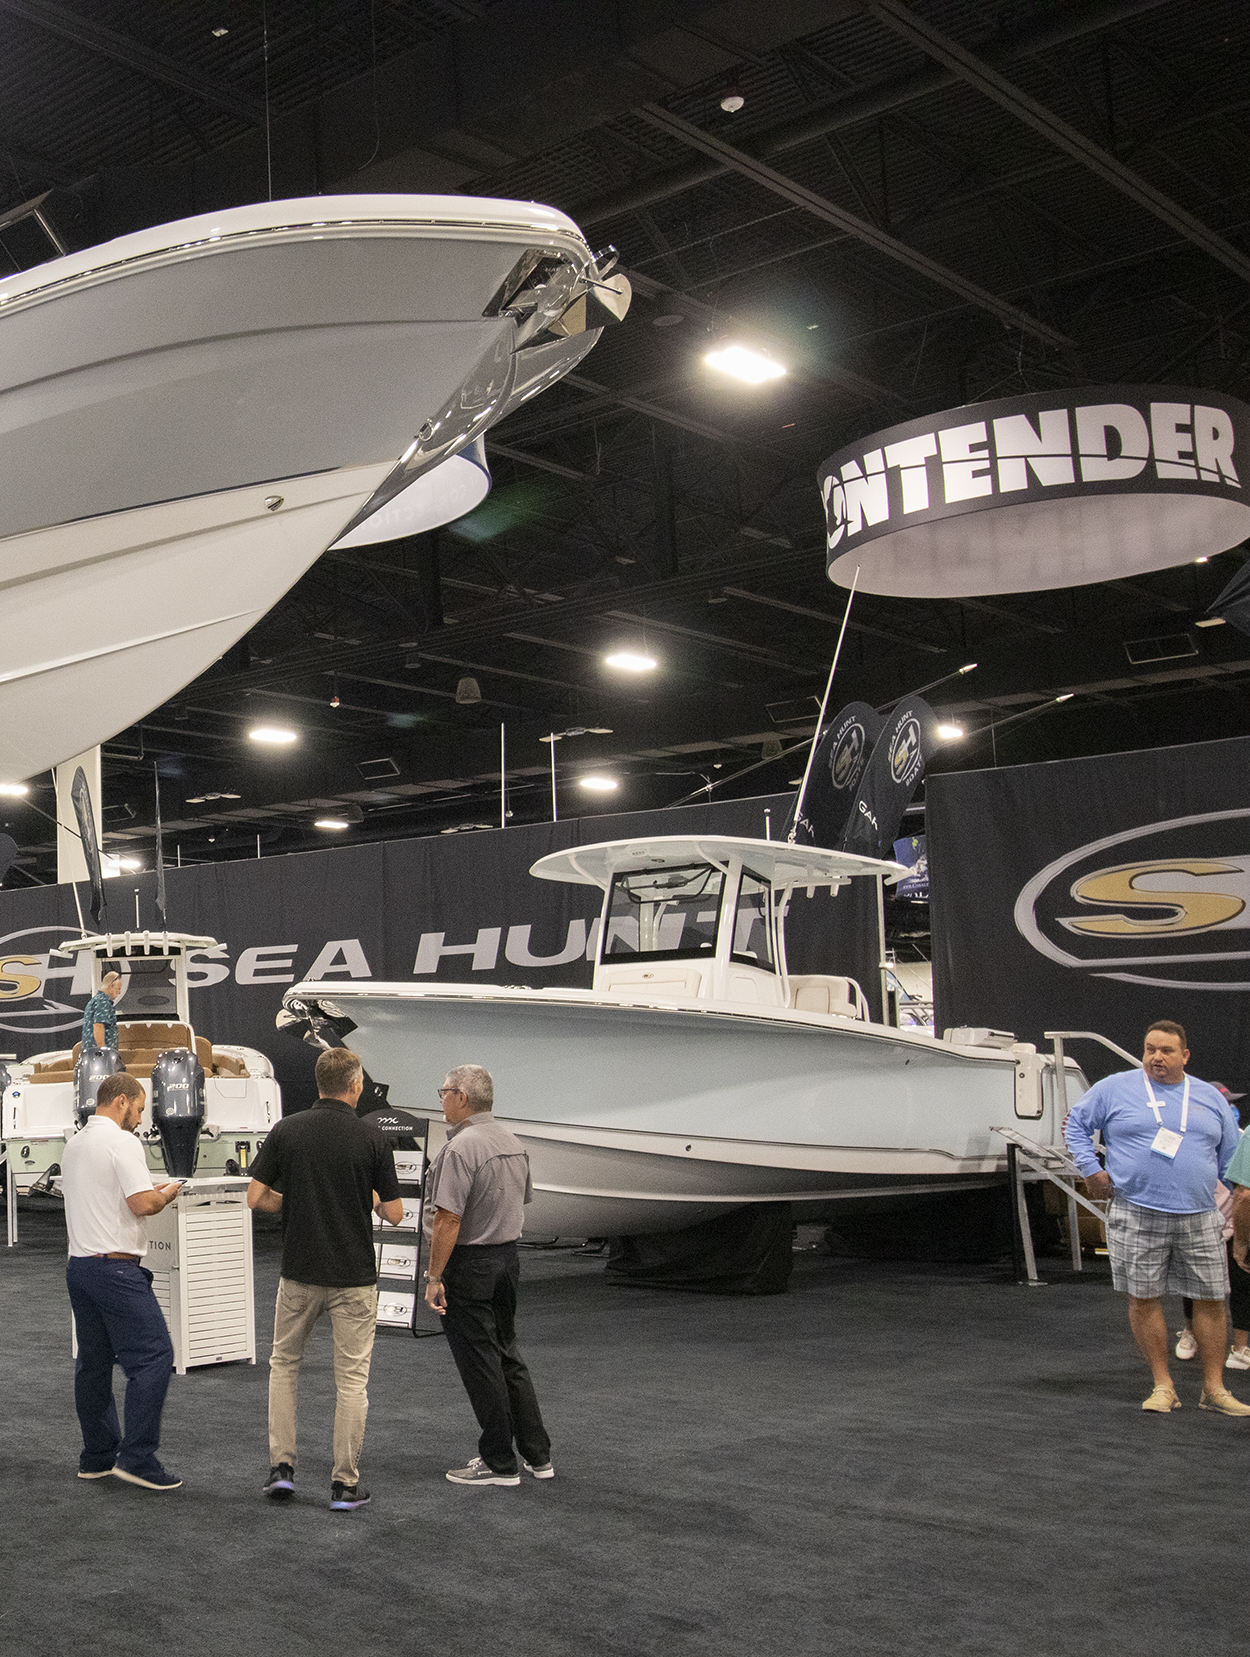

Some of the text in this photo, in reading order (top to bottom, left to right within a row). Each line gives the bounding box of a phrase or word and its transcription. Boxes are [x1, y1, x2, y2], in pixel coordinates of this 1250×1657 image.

[822, 403, 1241, 549] ONTENDER
[837, 715, 857, 740] HUNT
[895, 710, 913, 733] HUNT
[1055, 857, 1247, 939] S
[168, 904, 790, 988] SEA HUNT
[167, 1083, 190, 1092] 200
